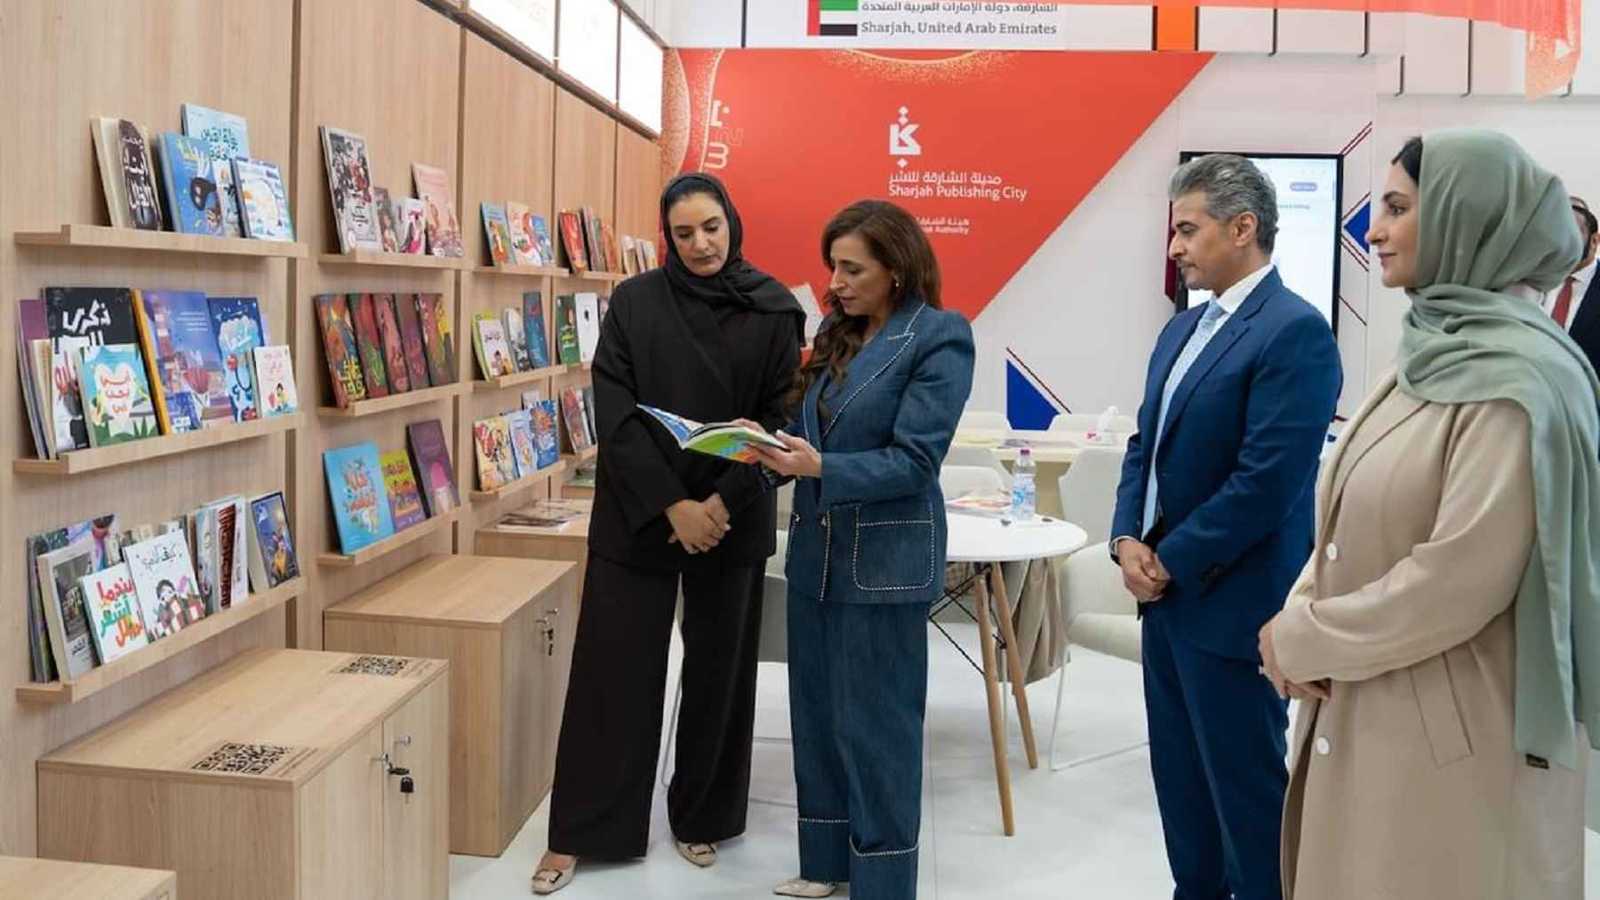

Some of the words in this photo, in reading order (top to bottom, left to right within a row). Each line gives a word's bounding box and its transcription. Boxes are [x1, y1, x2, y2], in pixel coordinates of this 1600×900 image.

[861, 22, 915, 36] Sharjah,
[918, 22, 961, 34] United
[964, 22, 996, 34] Arab
[999, 23, 1057, 35] Emirates
[922, 171, 967, 186] الشارقة
[970, 171, 1002, 185] مدينة
[888, 184, 934, 199] Sharjah
[936, 185, 1000, 201] Publishing
[1002, 186, 1027, 201] City
